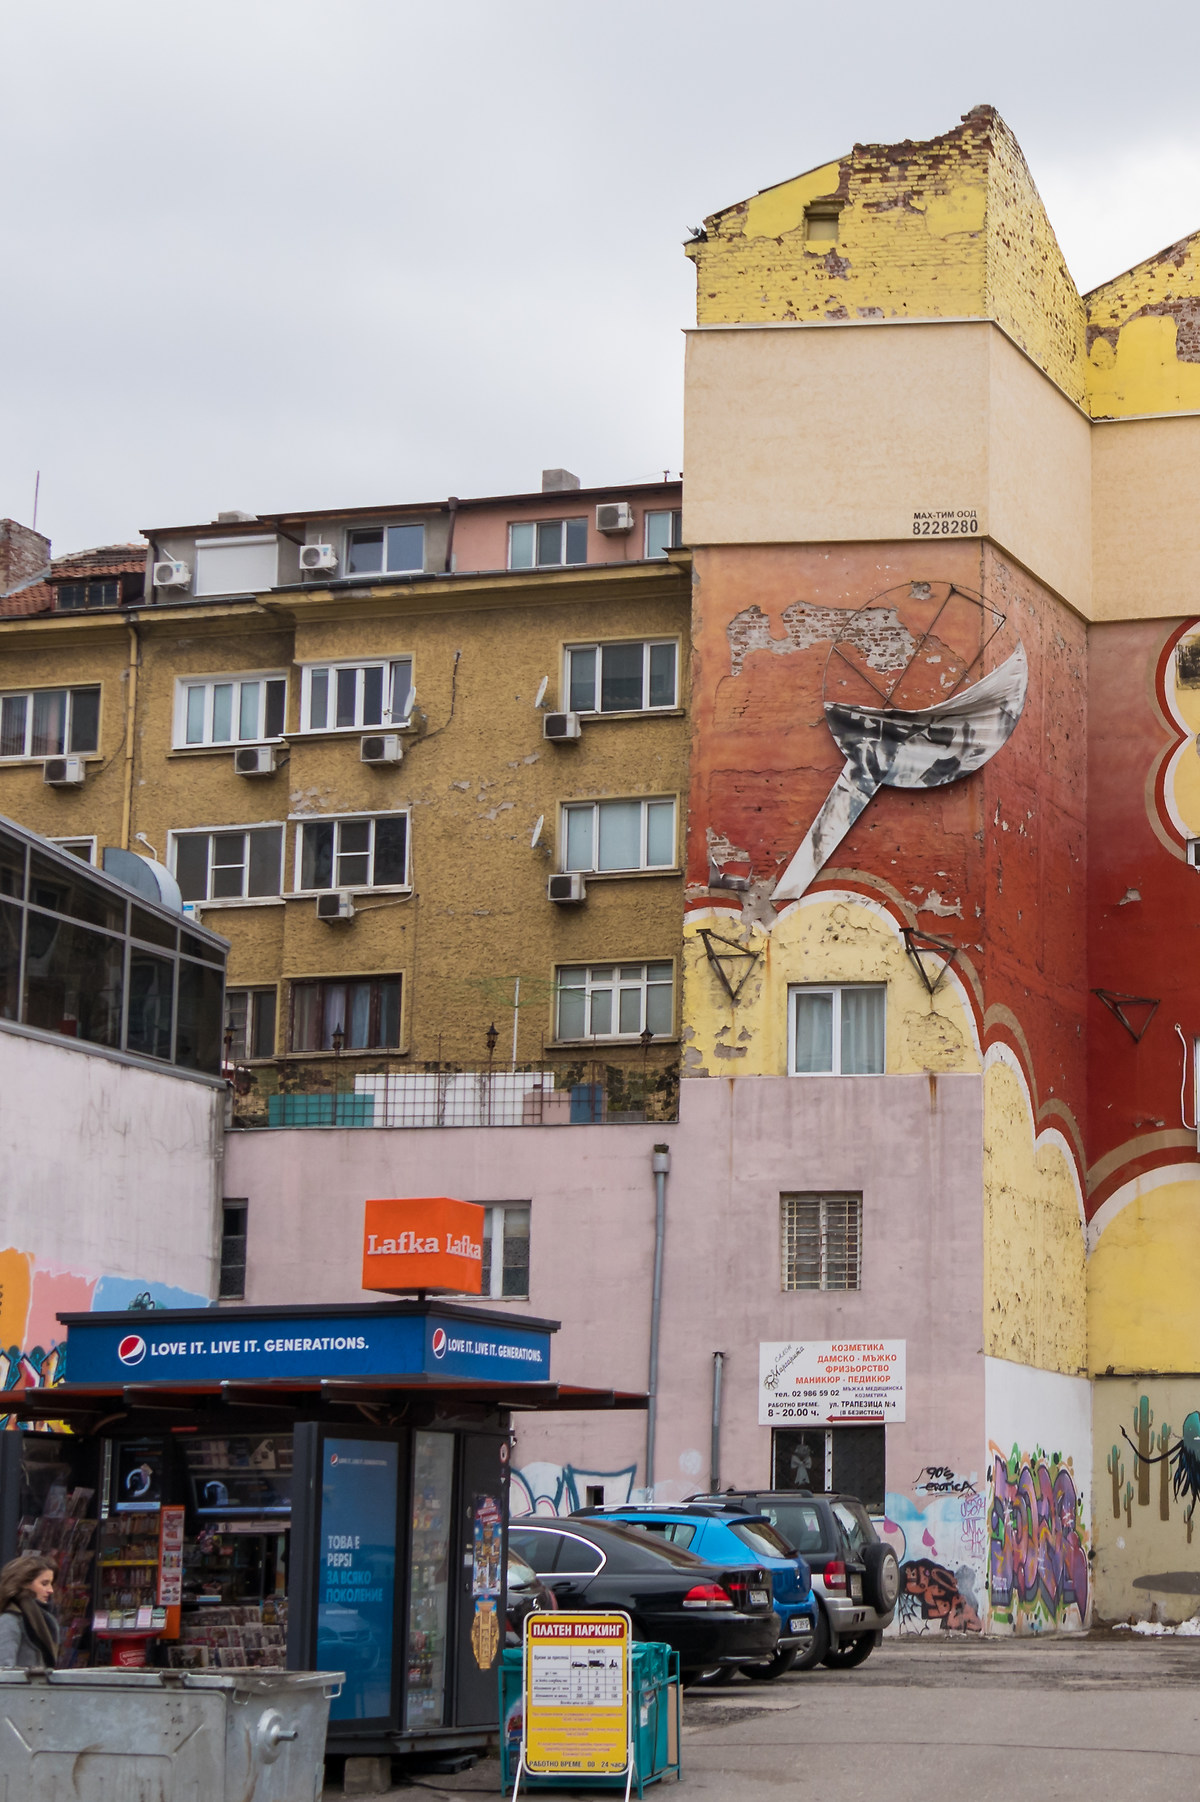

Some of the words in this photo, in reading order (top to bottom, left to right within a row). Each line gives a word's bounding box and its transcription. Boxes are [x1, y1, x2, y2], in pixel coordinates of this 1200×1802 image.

[956, 510, 977, 518] ООД
[912, 520, 978, 535] 8228280
[367, 1231, 440, 1256] Lafka
[445, 1233, 482, 1260] Lafka
[151, 1343, 186, 1356] LOVE
[190, 1342, 206, 1354] IT.
[210, 1341, 240, 1353] LIVE
[244, 1340, 261, 1352] IT.
[264, 1336, 369, 1352] GENERATIONS.
[447, 1338, 464, 1352] LOVE
[465, 1341, 474, 1354] IT.
[474, 1342, 488, 1356] LIVE
[488, 1343, 498, 1357] IT.
[498, 1345, 543, 1362] GENERATIONS.
[831, 1344, 885, 1352] КОЗМЕТИКА
[817, 1355, 855, 1363] ДАМСКО
[862, 1354, 897, 1362] МЪЖКО
[825, 1364, 889, 1374] ФРИЗЬОРСТВО
[795, 1376, 841, 1384] МАНИКЮР
[848, 1375, 891, 1384] ПЕДИКЮР
[768, 1409, 774, 1417] 8
[782, 1409, 808, 1417] 20.00
[328, 1536, 353, 1549] ТОВА
[327, 1553, 352, 1567] PEPSI
[326, 1571, 339, 1585] ЗА
[341, 1571, 371, 1585] ВСЯКО
[326, 1588, 383, 1602] ПОКОЛЕНИЕ
[533, 1624, 572, 1636] ПЛАТЕН
[574, 1624, 622, 1636] ПАРКИНГ
